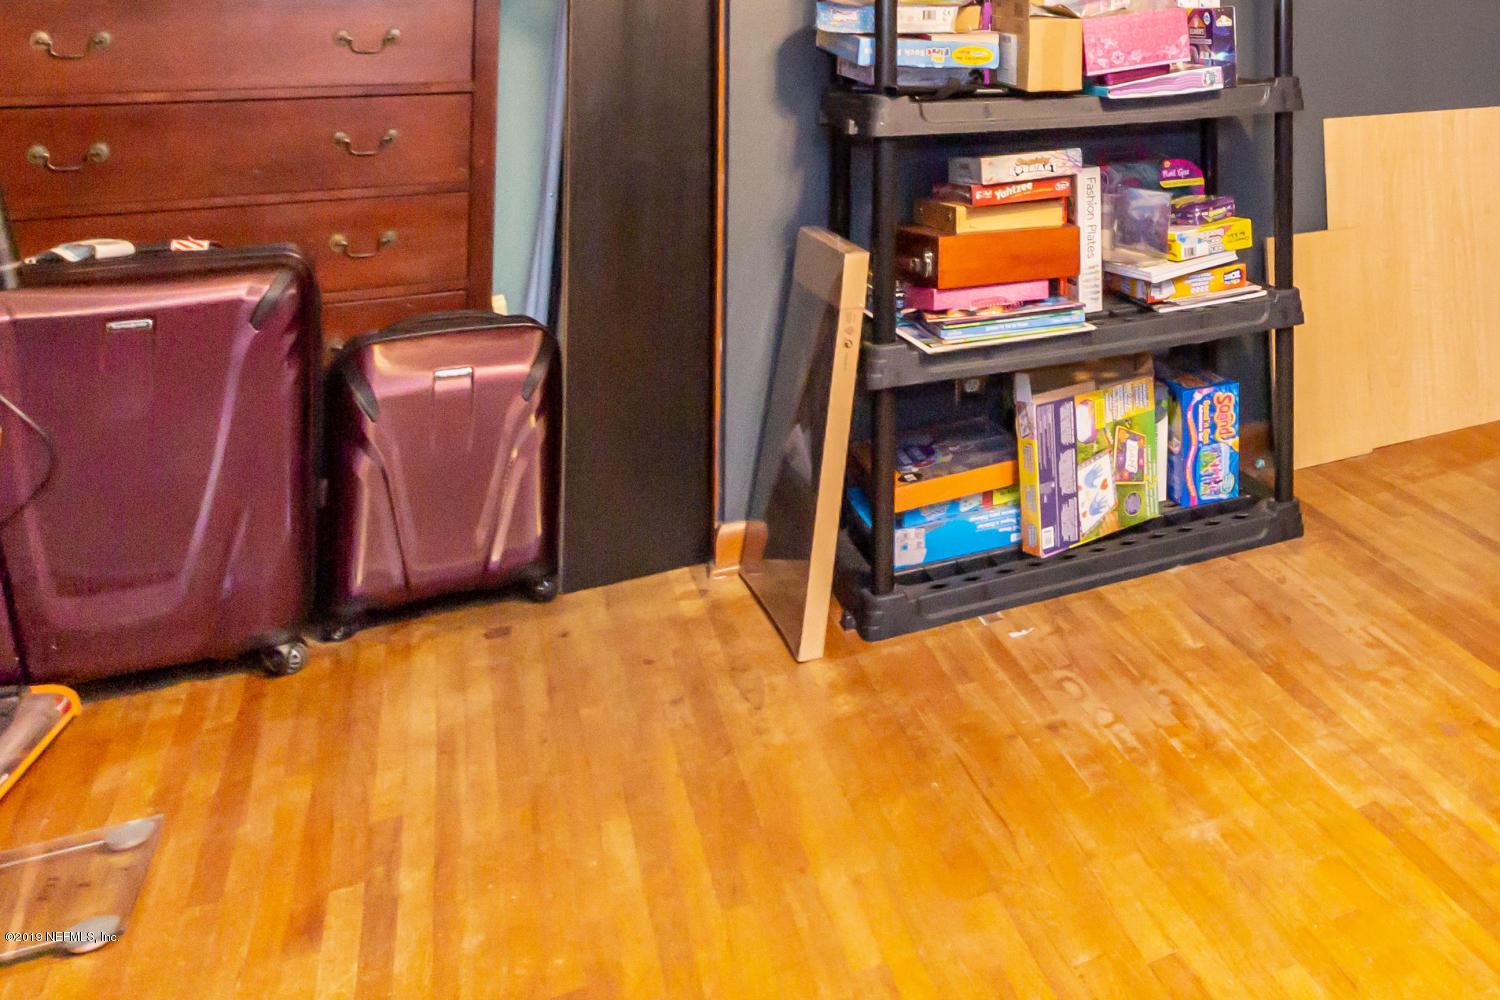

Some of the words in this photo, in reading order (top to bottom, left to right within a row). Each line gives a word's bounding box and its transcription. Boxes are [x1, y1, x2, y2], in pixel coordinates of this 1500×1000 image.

[994, 182, 1033, 201] Yahtzee
[1085, 177, 1096, 220] Fashion
[1087, 224, 1097, 259] Plates
